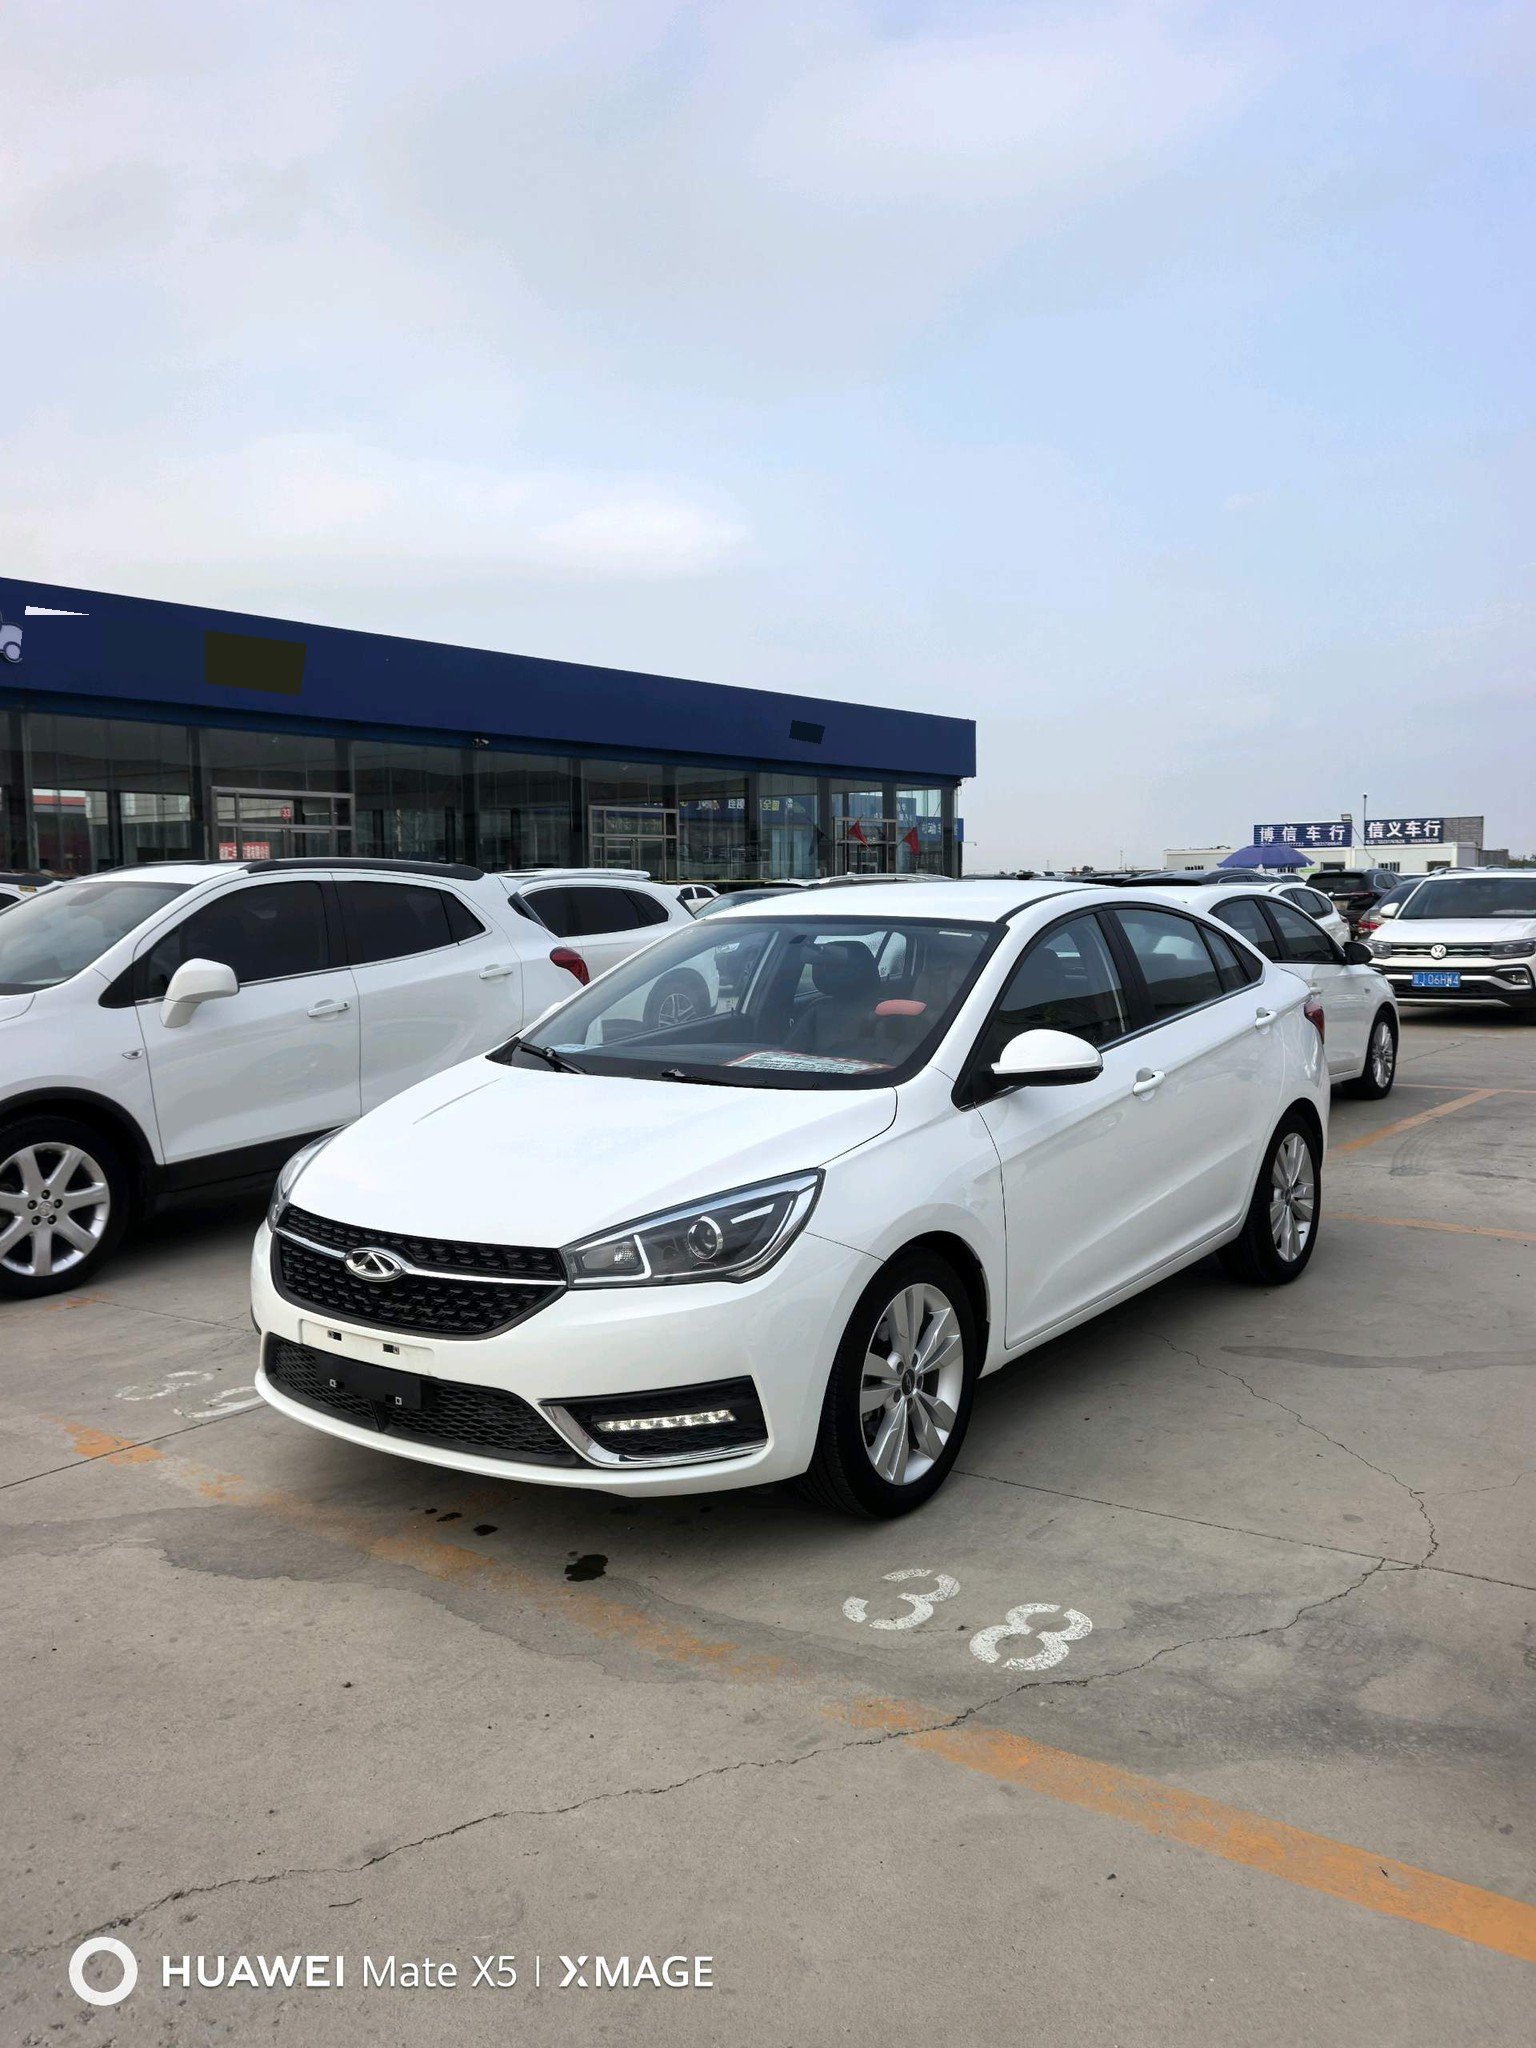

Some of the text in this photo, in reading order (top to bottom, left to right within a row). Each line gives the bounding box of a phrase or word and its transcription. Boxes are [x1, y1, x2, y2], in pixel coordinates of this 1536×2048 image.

[1259, 825, 1345, 842] 博信车行
[1367, 820, 1441, 838] 信义车行
[842, 1568, 1093, 1671] 38
